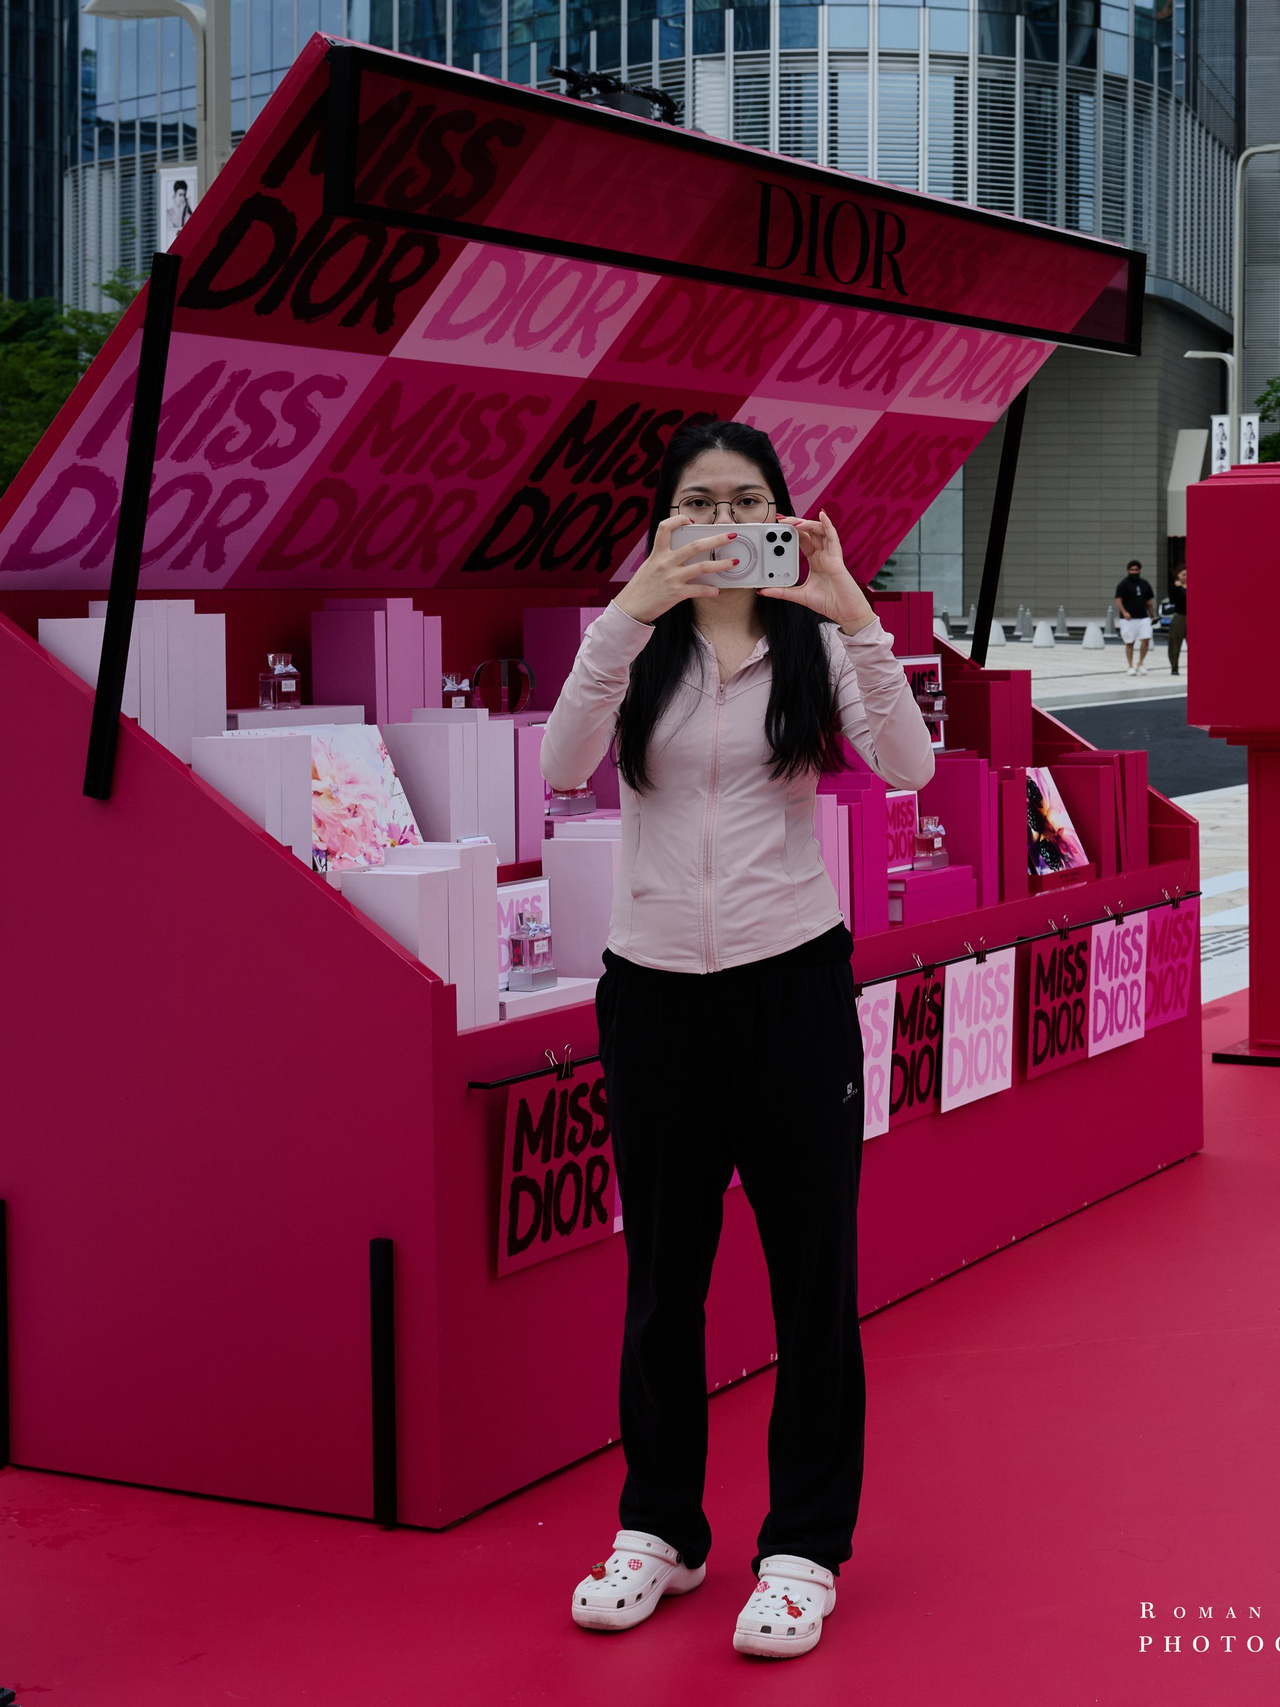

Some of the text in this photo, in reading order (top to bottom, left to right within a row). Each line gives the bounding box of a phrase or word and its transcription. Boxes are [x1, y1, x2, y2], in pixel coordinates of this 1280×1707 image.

[178, 192, 440, 334] DIOR
[752, 180, 908, 296] DIOR
[422, 243, 640, 359] DIOR
[617, 277, 800, 378] DIOR
[776, 304, 935, 395] DIOR
[909, 327, 1046, 408] DIOR
[329, 382, 551, 481] MISS
[832, 429, 975, 502] MISS
[256, 477, 478, 573] DIOR
[461, 486, 649, 573] DIOR
[887, 830, 916, 862] DIOR
[1034, 941, 1088, 1007] MISS
[1094, 923, 1143, 986] MISS
[1147, 910, 1194, 965] MISS
[892, 982, 945, 1050] MIS
[949, 962, 1010, 1034] MISS
[1093, 979, 1142, 1044] DIOR
[1145, 963, 1189, 1022] DIOR
[947, 1024, 1008, 1099] DIOR
[1033, 999, 1086, 1067] DIOR
[513, 1078, 611, 1173] MISS
[508, 1155, 610, 1257] DIOR
